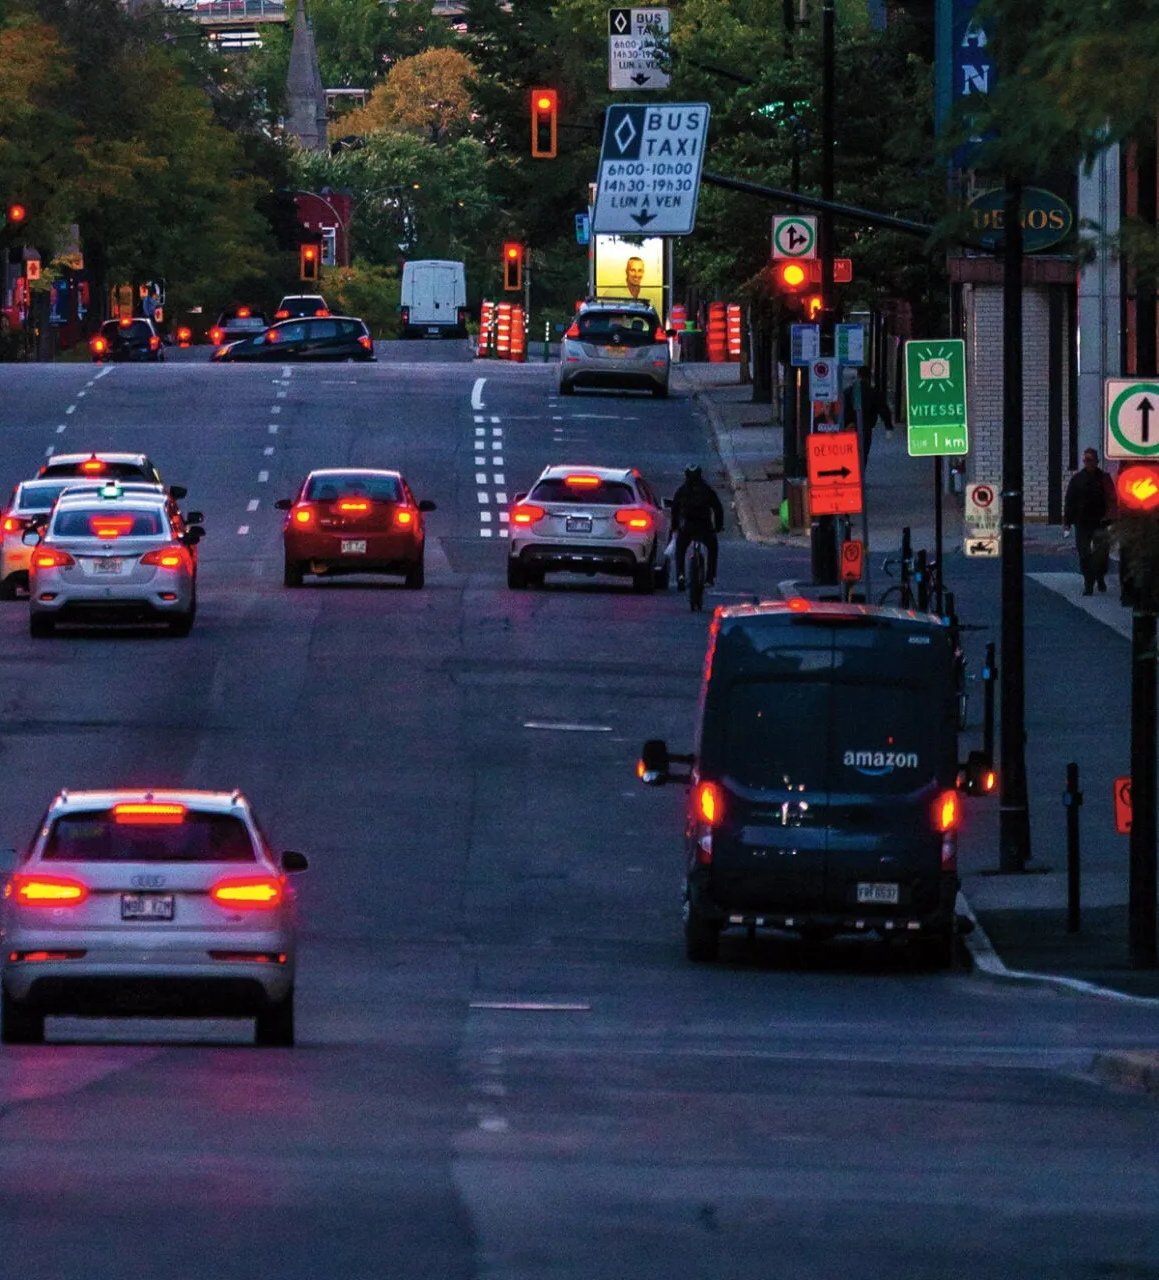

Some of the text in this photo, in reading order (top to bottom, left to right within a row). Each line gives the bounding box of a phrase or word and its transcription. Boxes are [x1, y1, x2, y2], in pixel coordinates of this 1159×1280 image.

[636, 13, 661, 24] BUS
[637, 26, 663, 35] TA
[647, 112, 701, 131] BUS
[645, 137, 698, 157] TAXI
[607, 162, 693, 177] 6h00-10h00
[603, 179, 693, 193] 14h30-19h30
[610, 197, 637, 209] LUN
[656, 195, 682, 208] VEN
[971, 207, 1065, 230] DEOS
[911, 403, 964, 417] VITESSE
[933, 431, 939, 448] 1
[944, 437, 965, 449] km
[843, 750, 919, 769] amazon
